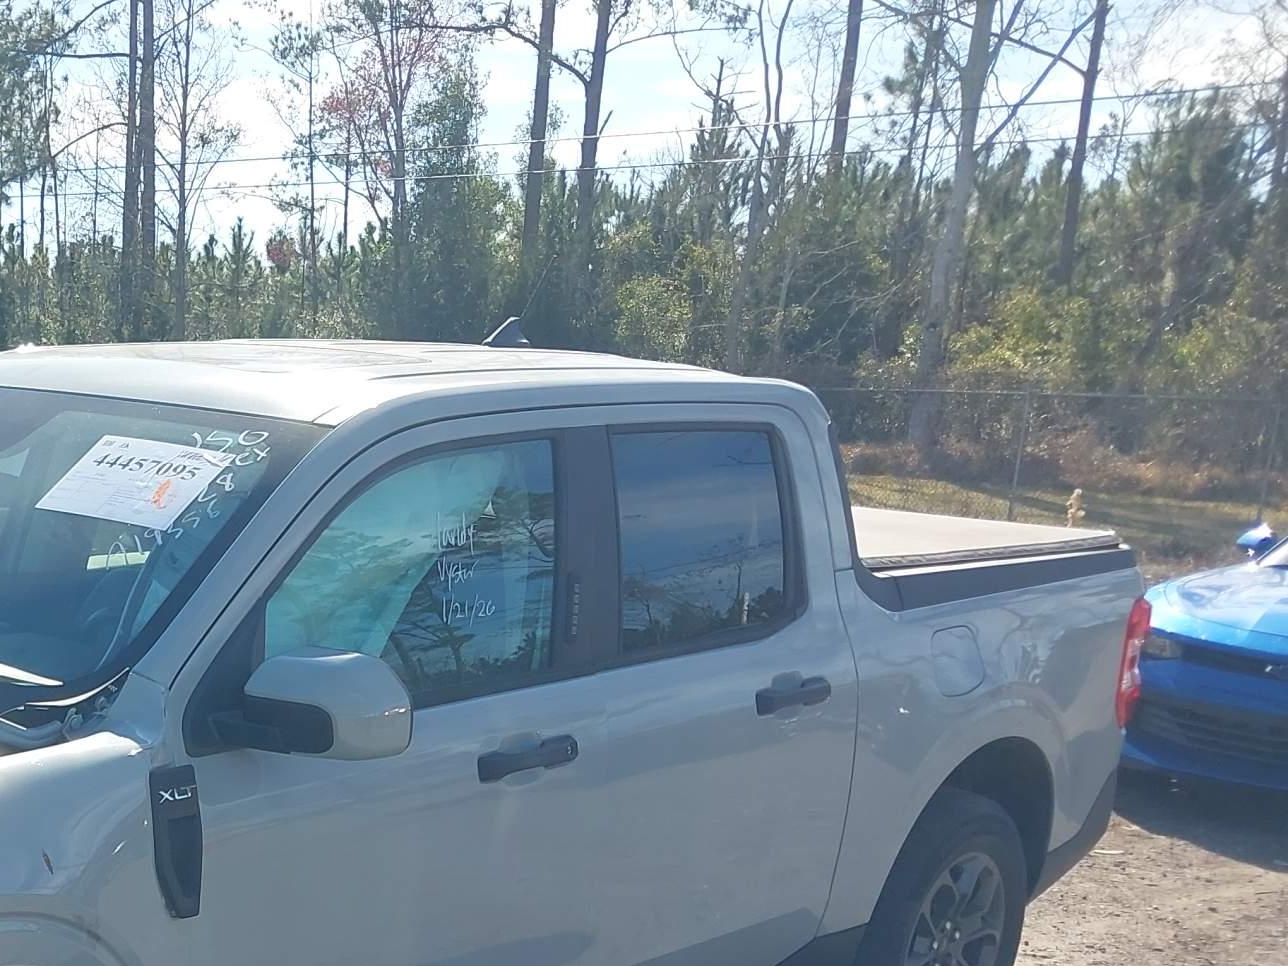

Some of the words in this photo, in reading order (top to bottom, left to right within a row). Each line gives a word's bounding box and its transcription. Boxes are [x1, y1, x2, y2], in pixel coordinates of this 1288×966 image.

[93, 453, 201, 480] 44457095
[442, 593, 496, 627] 1/21/26
[159, 785, 197, 803] XLT
